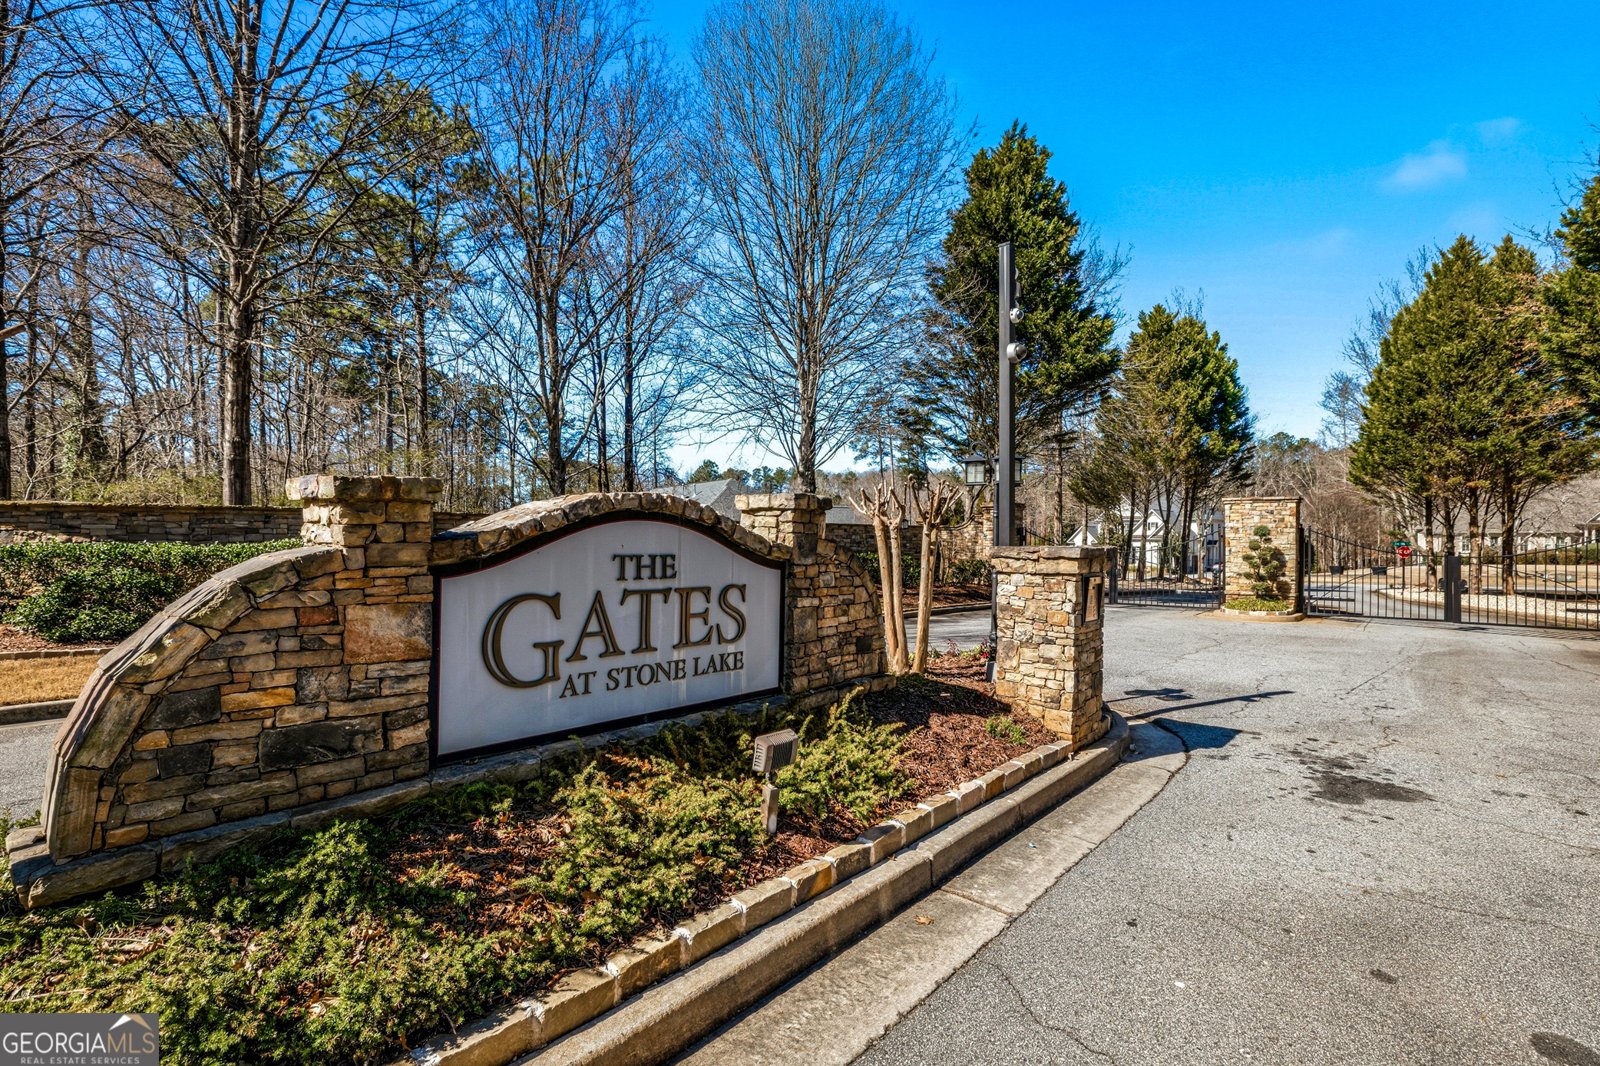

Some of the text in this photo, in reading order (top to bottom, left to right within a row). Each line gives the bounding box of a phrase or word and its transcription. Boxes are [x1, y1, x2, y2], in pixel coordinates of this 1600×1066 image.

[612, 553, 677, 582] THE
[482, 583, 747, 688] GATES
[559, 651, 744, 698] AT STONE LAKE
